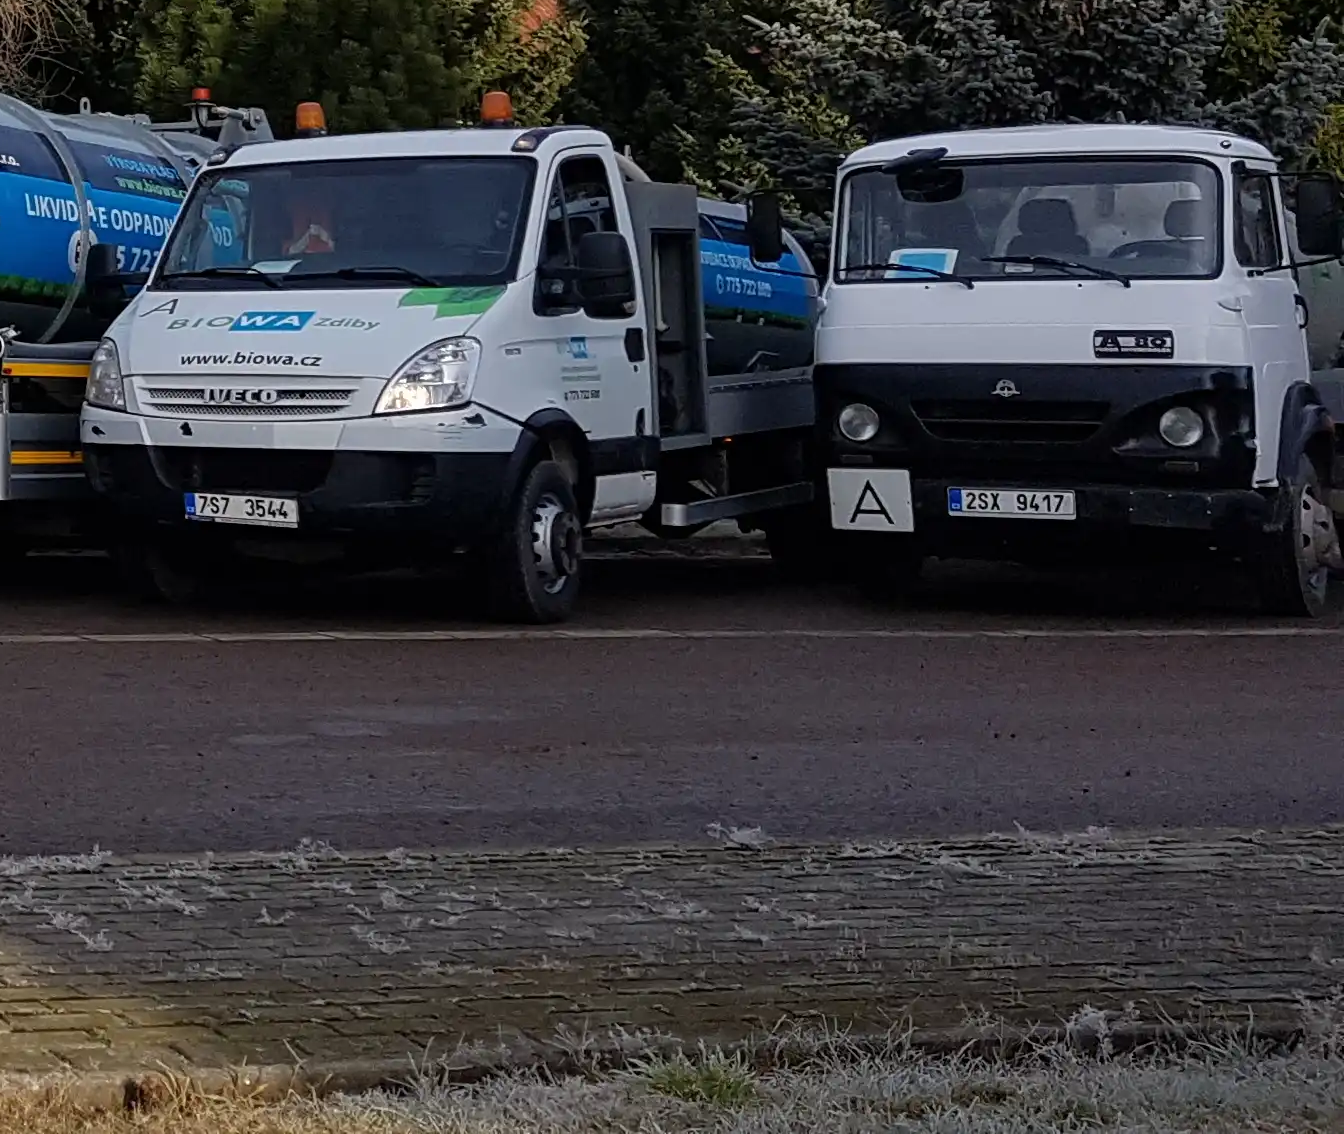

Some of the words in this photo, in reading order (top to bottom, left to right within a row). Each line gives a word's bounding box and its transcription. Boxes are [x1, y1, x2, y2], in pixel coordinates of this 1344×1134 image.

[25, 193, 108, 229] LIKVIDAE
[140, 298, 179, 317] A
[167, 315, 301, 330] BIOWA
[312, 317, 381, 331] Zdiby
[180, 352, 323, 366] www.biowa.cz
[203, 388, 278, 404] IVECO
[198, 495, 230, 515] 7S7
[244, 498, 288, 519] 3544
[849, 479, 895, 525] A
[965, 492, 1001, 511] 2SX
[1016, 494, 1064, 513] 9417
